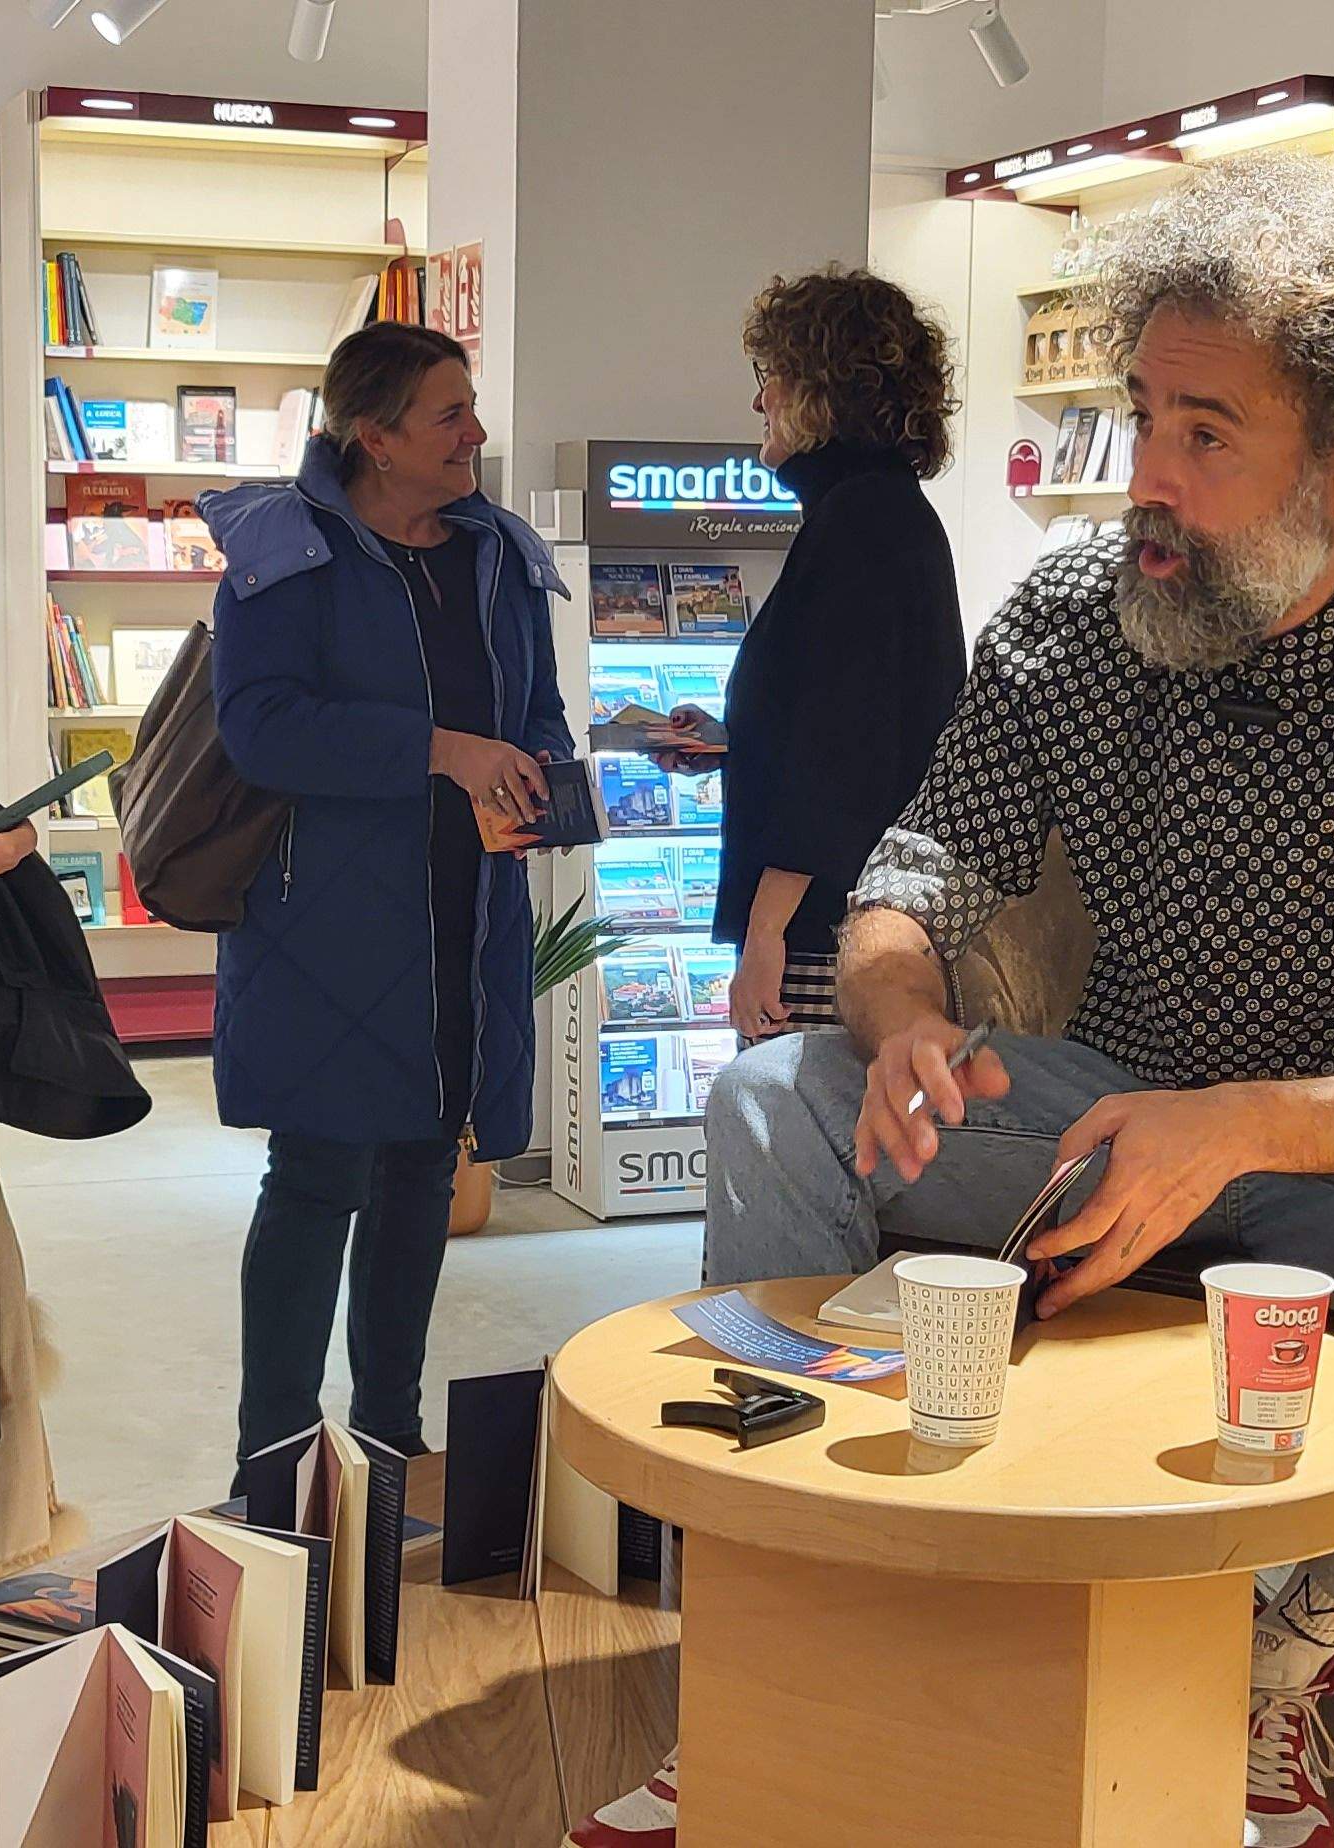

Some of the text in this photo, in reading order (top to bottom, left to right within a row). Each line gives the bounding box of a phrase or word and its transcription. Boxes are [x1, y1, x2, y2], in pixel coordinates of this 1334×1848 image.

[214, 103, 274, 125] HUESCA
[565, 973, 579, 1191] smartbo
[1255, 1304, 1319, 1327] eboca
